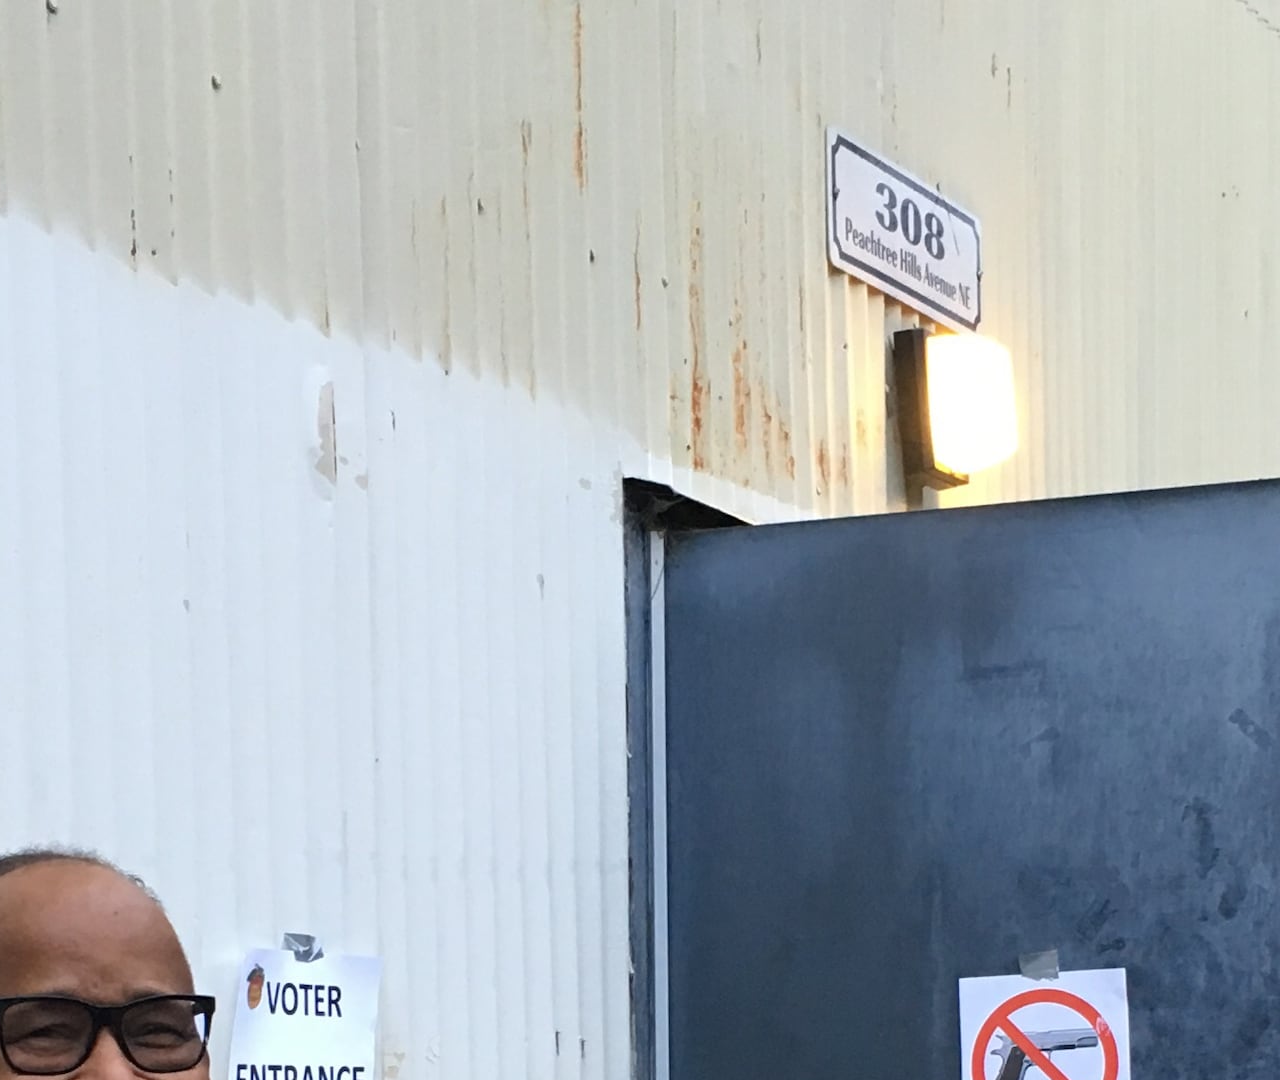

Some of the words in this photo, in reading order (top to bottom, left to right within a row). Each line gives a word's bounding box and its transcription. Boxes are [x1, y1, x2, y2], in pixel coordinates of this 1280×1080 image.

[875, 182, 945, 261] 308
[845, 216, 898, 268] Peachtree
[900, 248, 922, 282] Hills
[923, 262, 957, 302] Avenue
[958, 281, 971, 310] NE
[266, 981, 343, 1018] VOTER
